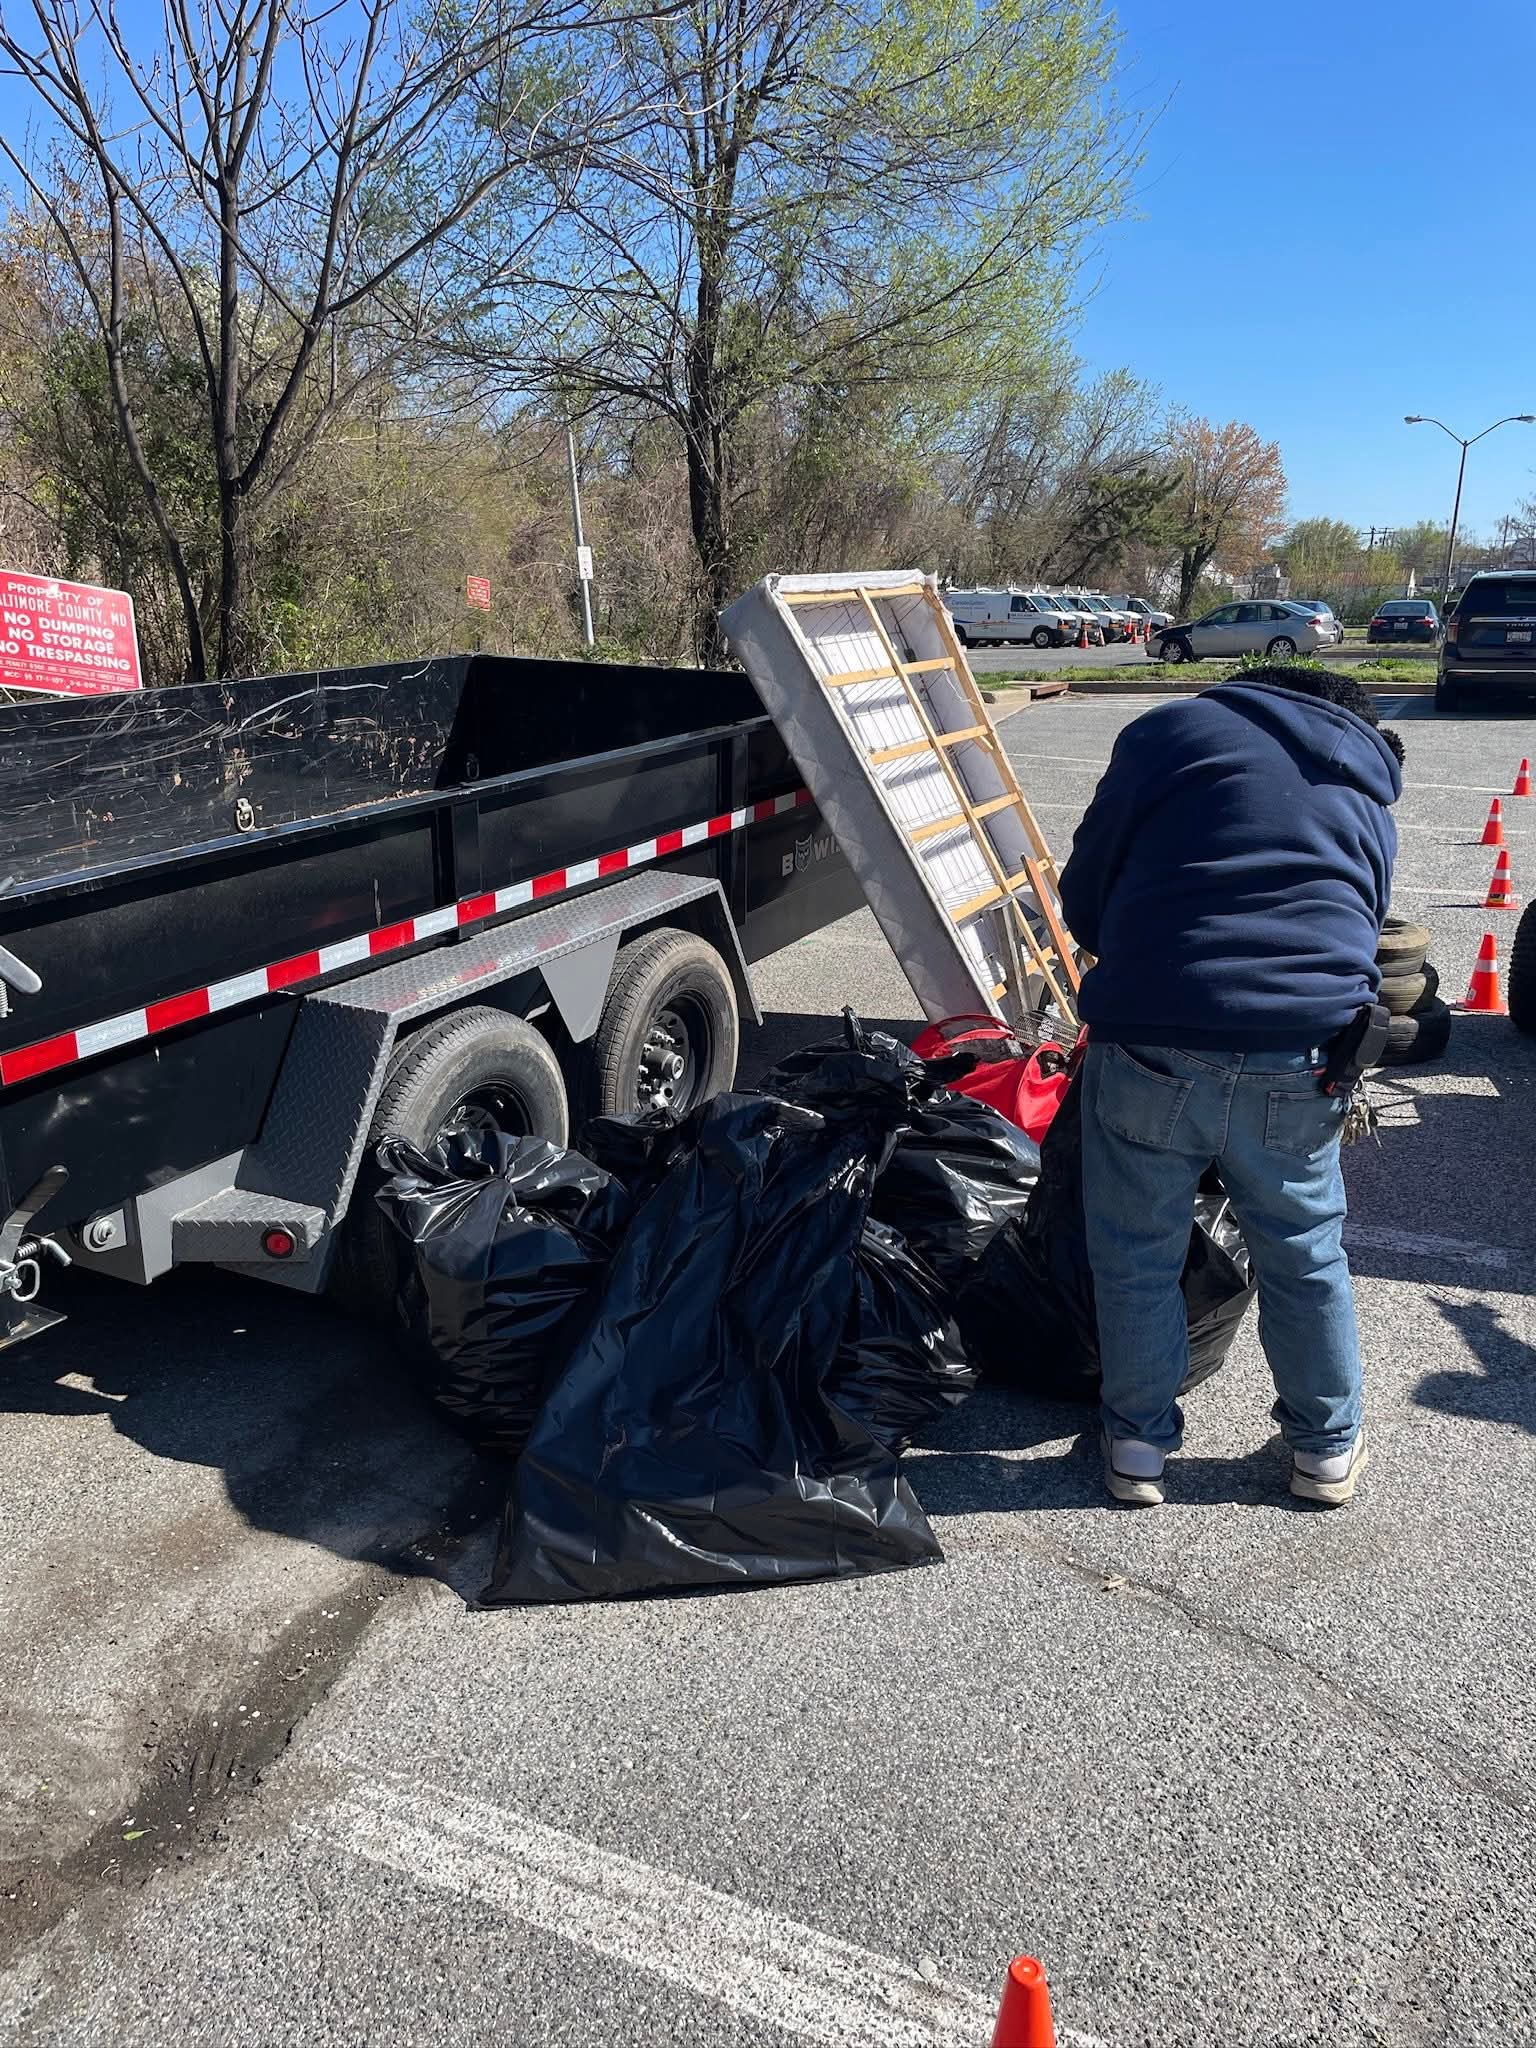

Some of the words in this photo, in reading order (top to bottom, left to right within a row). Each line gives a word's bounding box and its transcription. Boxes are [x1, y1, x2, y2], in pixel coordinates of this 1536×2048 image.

[8, 581, 80, 603] PROPERTY
[87, 596, 104, 606] OF
[3, 611, 31, 626] NO
[38, 617, 115, 640] DUMPING
[111, 612, 127, 627] MD
[8, 627, 35, 641] NO
[42, 632, 115, 654] STORAGE
[26, 643, 131, 670] TRESPASSING
